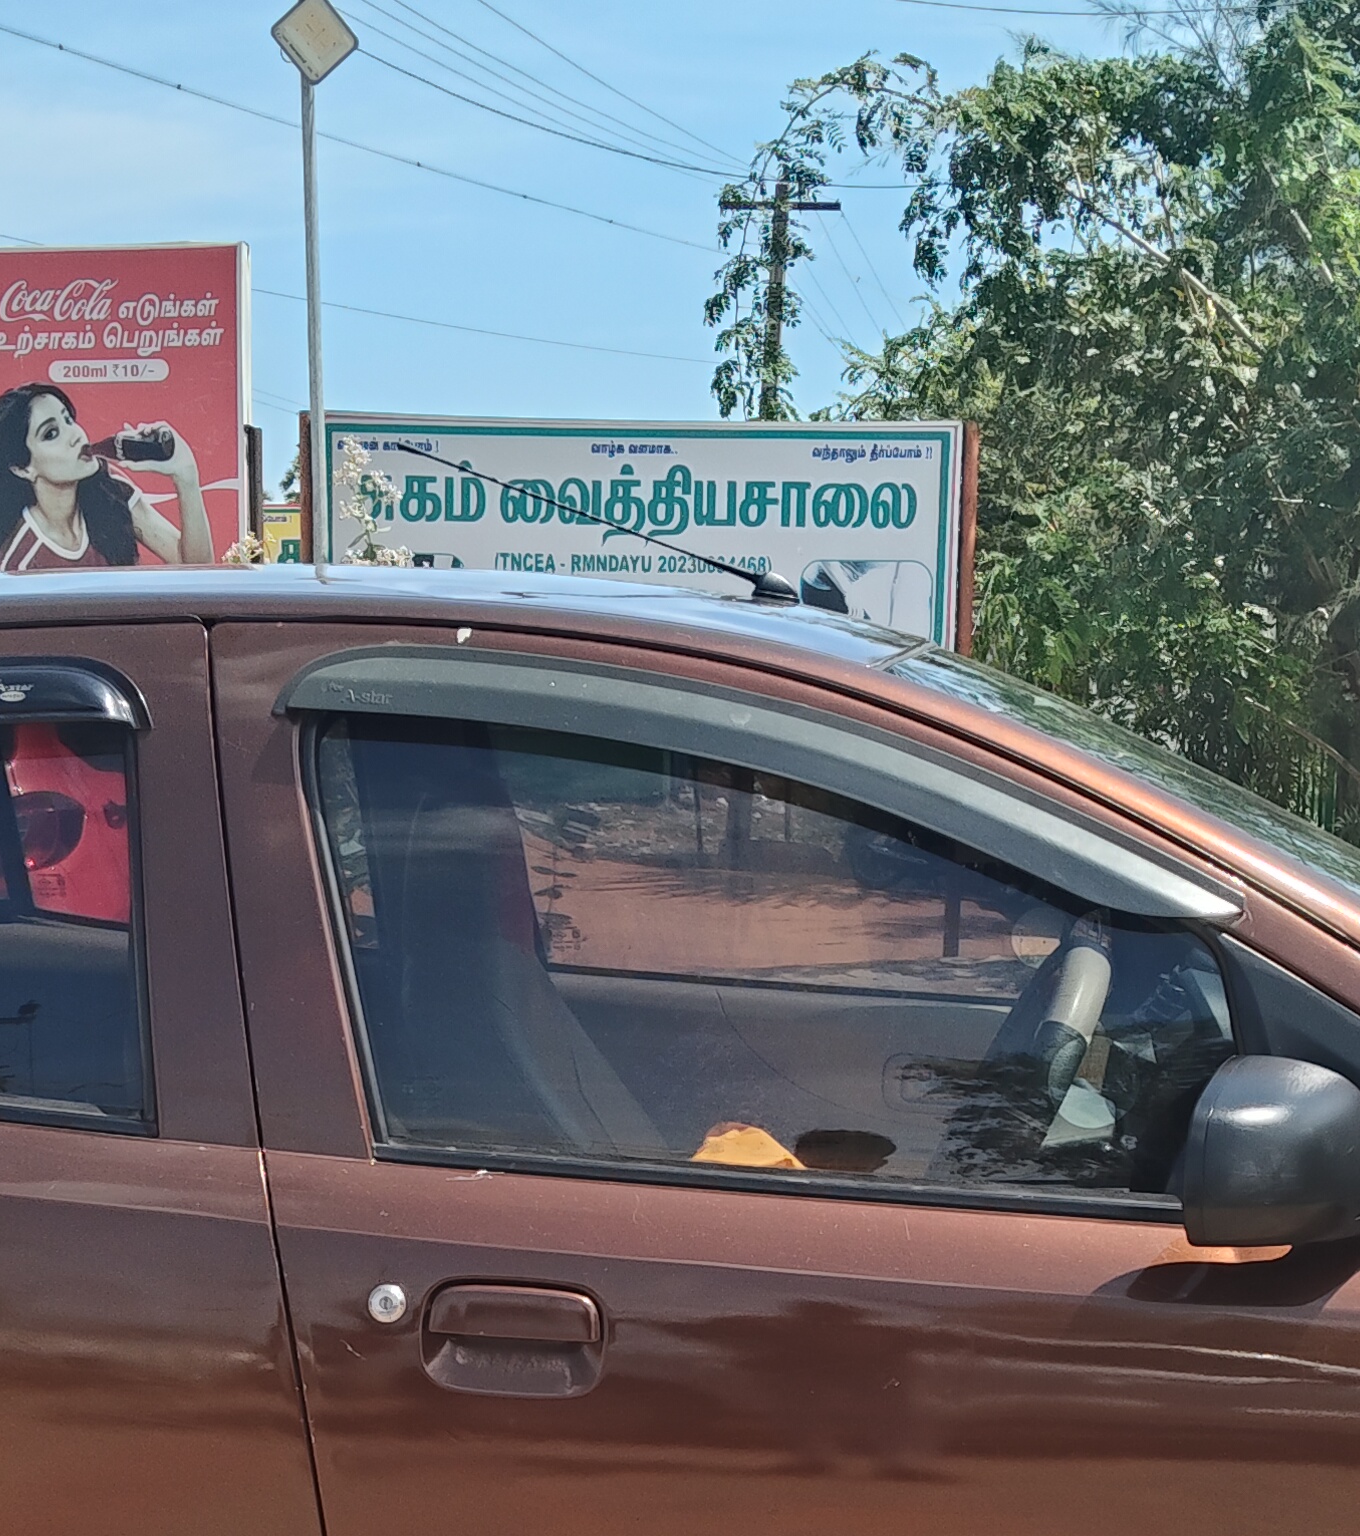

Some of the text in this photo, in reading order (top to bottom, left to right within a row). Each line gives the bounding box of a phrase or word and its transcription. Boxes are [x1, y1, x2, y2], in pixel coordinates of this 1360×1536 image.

[0, 278, 119, 322] Coca-Cola
[119, 292, 220, 326] எடுங்கள்
[103, 321, 225, 357] பெறுங்கள்
[63, 363, 155, 379] 200ml ₹10/-
[591, 440, 625, 458] வாழ்க
[812, 444, 866, 463] வந்தாலும்
[500, 463, 918, 546] வைத்தியசாலை
[571, 553, 653, 574] RMNDAYU
